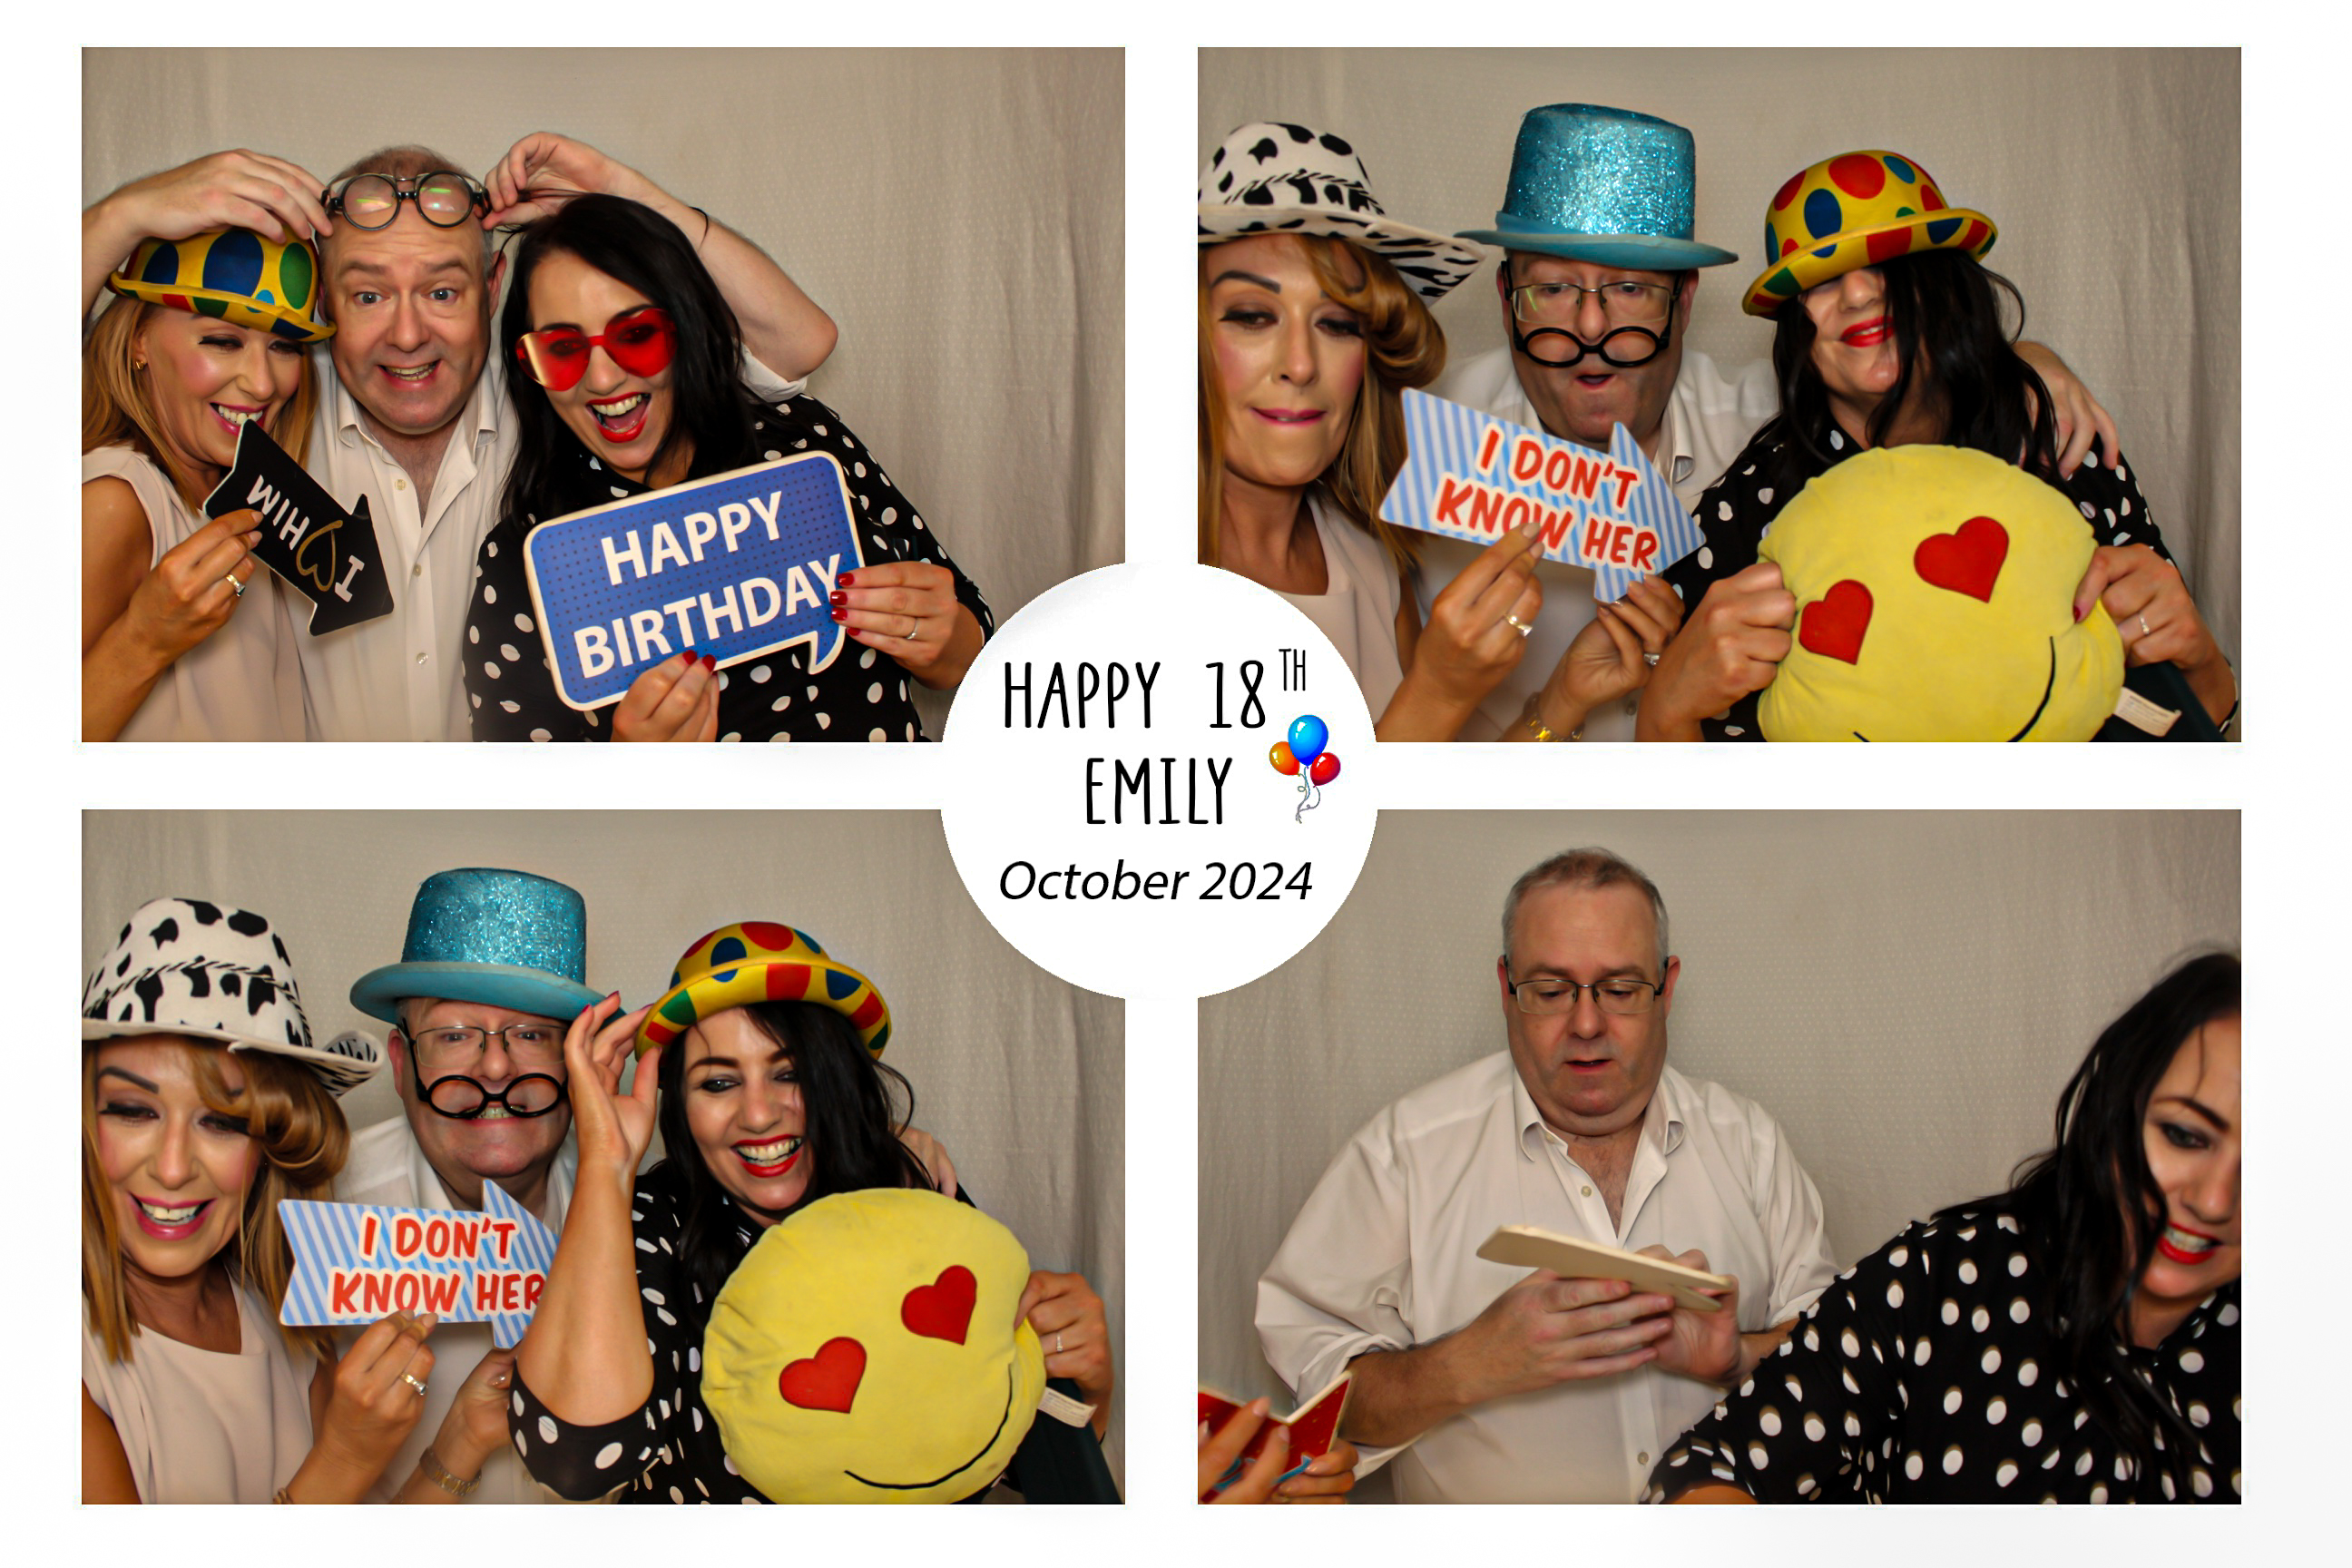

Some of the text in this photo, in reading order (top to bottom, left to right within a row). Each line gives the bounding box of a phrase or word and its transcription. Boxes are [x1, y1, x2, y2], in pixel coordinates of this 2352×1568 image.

[1478, 427, 1638, 509] I DON'T
[247, 475, 365, 603] I HIM
[601, 491, 782, 586] HAPPY
[1436, 477, 1658, 572] KNOW HER
[573, 553, 841, 679] BIRTHDAY
[361, 1216, 516, 1260] I DON'T
[331, 1271, 545, 1315] KNOW HER
